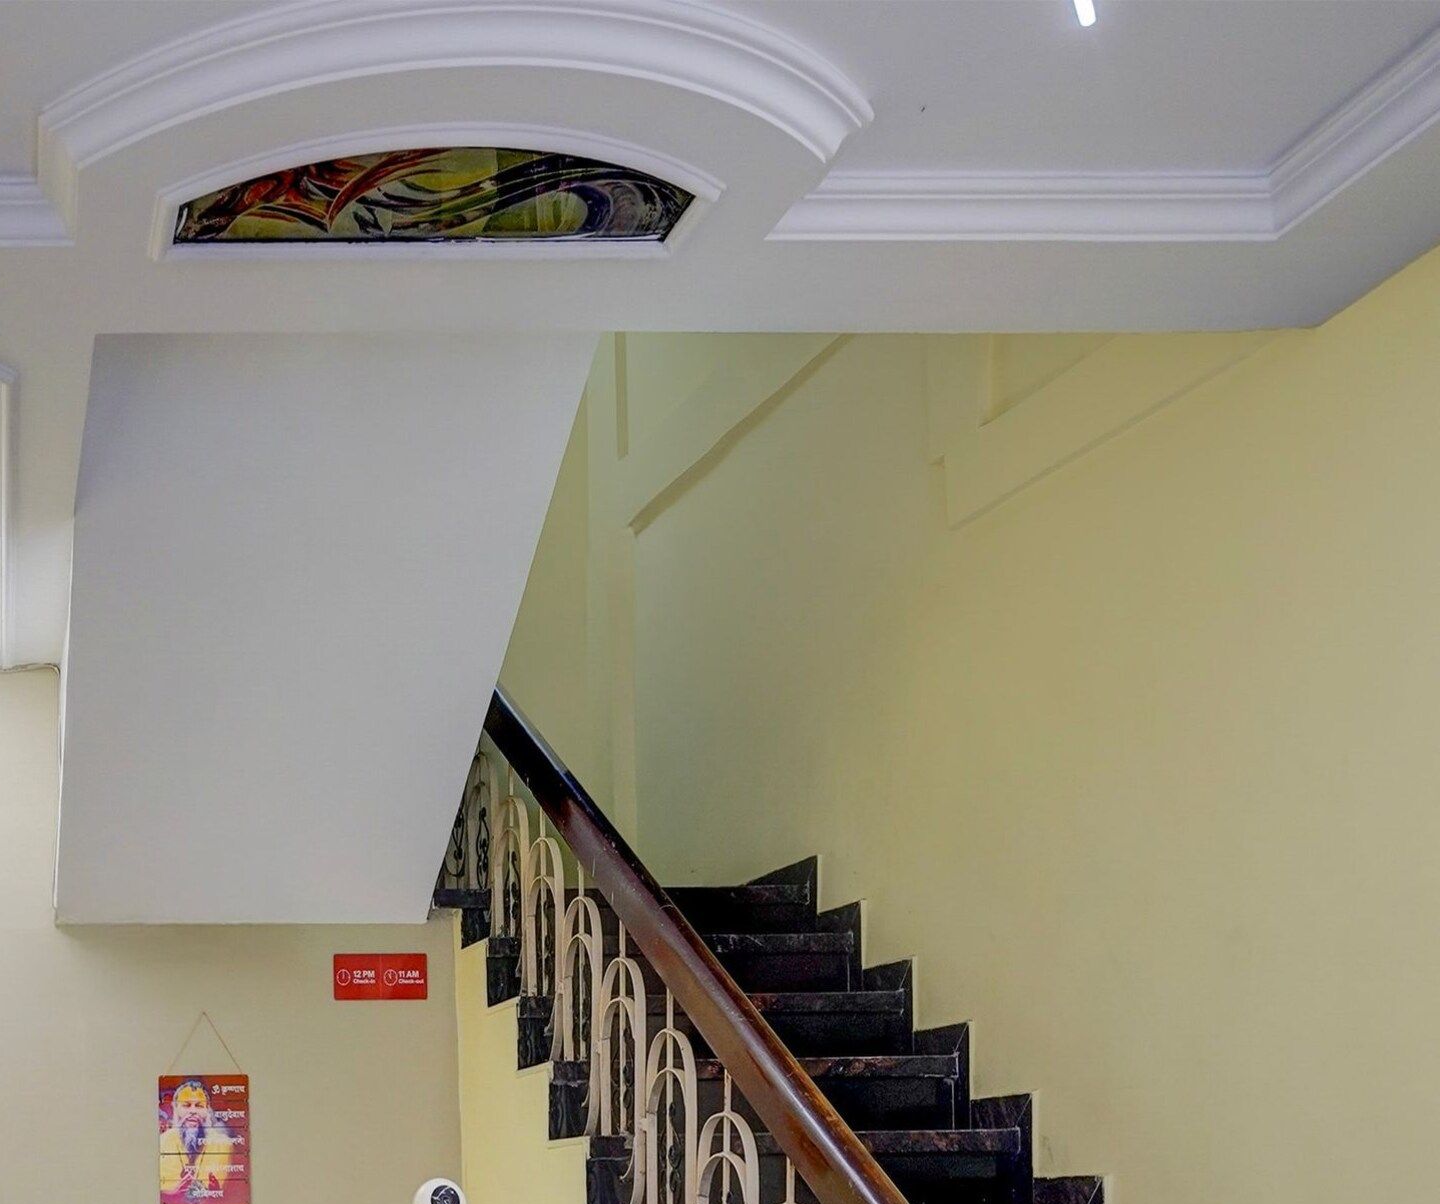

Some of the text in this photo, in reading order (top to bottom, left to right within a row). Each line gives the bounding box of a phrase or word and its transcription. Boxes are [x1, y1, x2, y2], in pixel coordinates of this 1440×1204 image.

[353, 970, 375, 978] 12 PM
[398, 970, 419, 978] 11 AM
